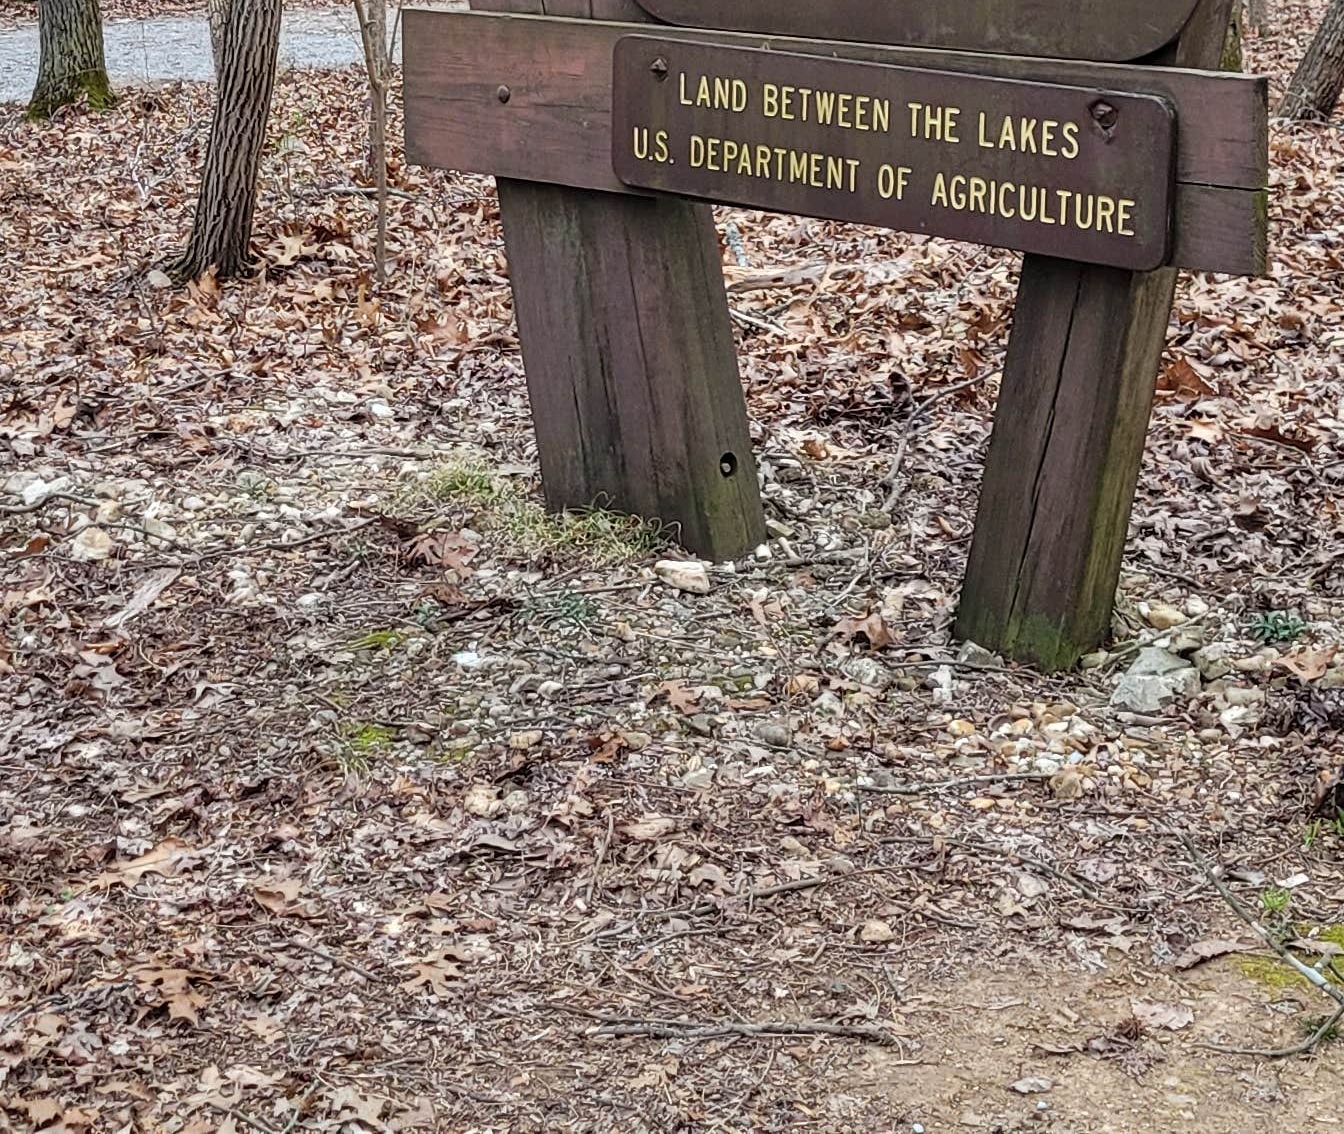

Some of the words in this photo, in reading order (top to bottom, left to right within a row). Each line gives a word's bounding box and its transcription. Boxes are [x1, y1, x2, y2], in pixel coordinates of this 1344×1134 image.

[678, 71, 748, 113] LAND
[762, 83, 891, 133] BETWEEN
[908, 102, 961, 144] THE
[978, 111, 1080, 161] LAKES
[632, 127, 675, 165] U.S.
[690, 135, 860, 194] DEPARTMENT
[877, 164, 913, 201] OF
[931, 172, 1136, 237] AGRICULTURE
